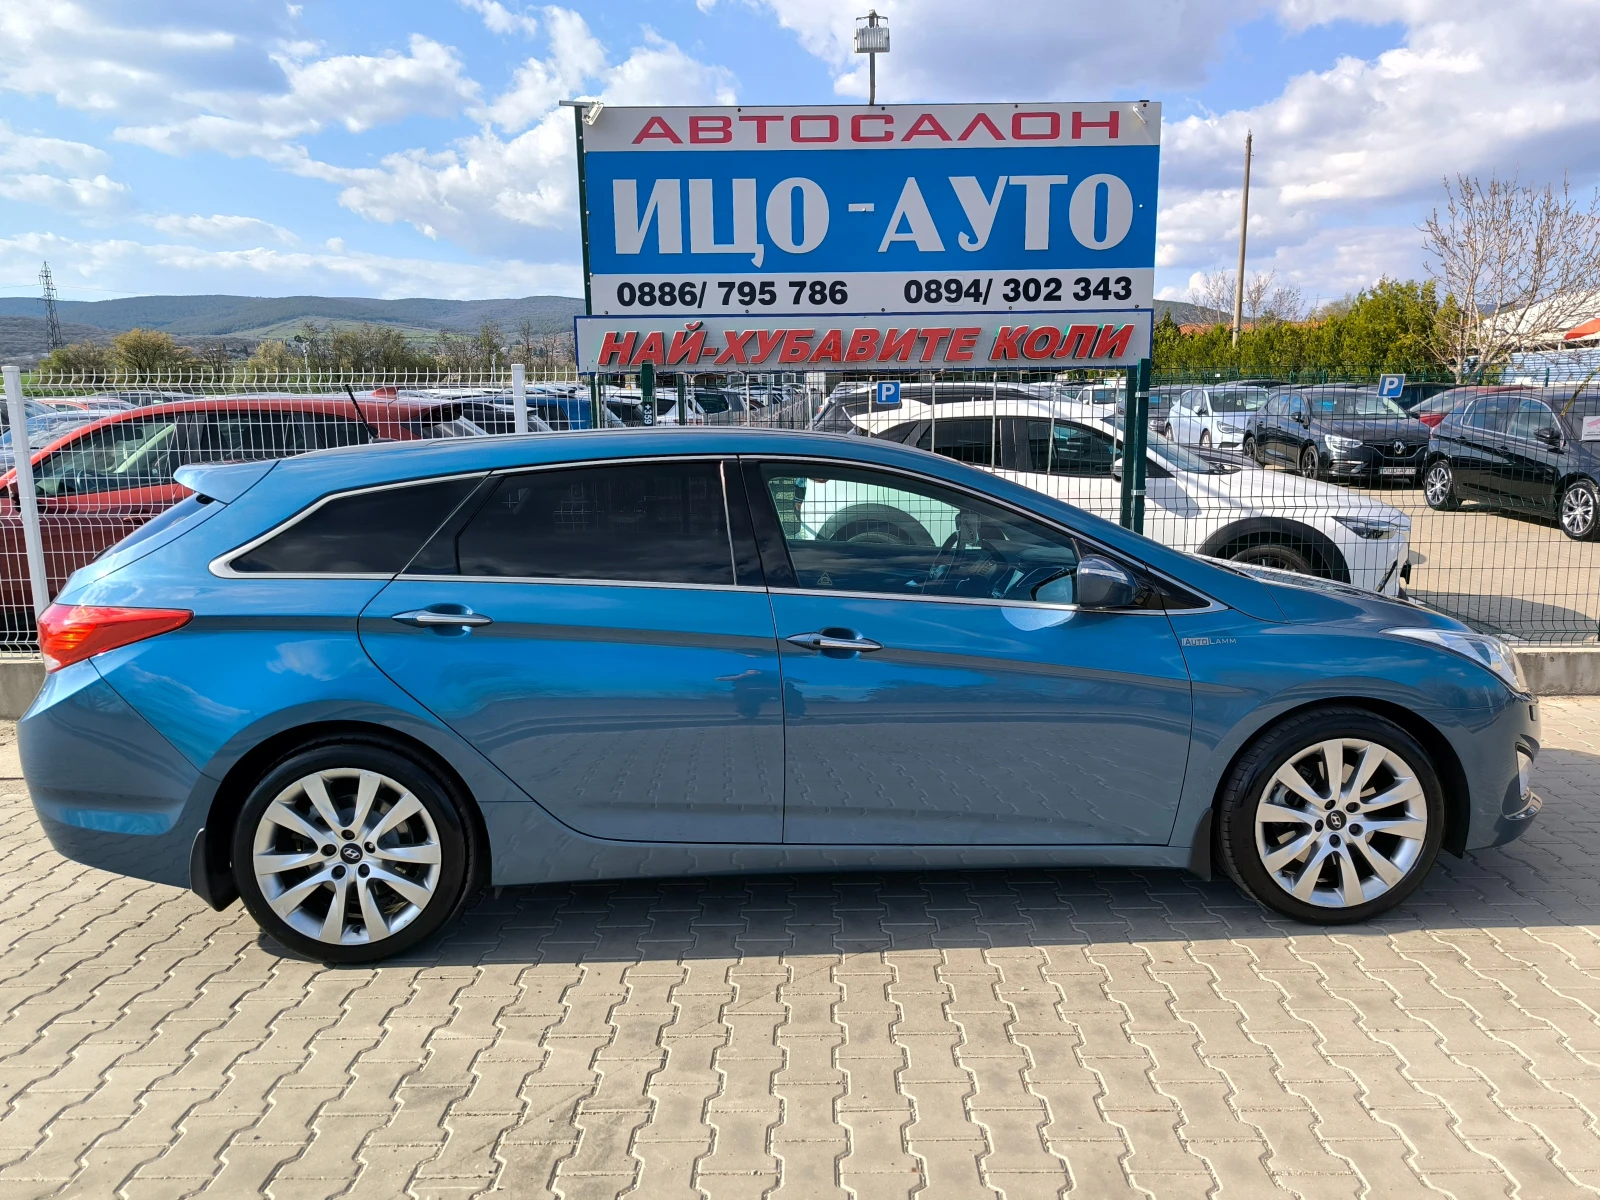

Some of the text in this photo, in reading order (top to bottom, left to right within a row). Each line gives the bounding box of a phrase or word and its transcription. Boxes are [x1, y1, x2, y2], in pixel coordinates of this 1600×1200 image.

[632, 110, 1120, 145] АВТОСАЛОН
[616, 277, 1133, 309] 0886/ 795 786 0894/ 302 343
[597, 321, 1135, 366] НАЙ-ХУБАВИТЕ КОЛИ
[882, 383, 895, 401] P
[1383, 377, 1398, 394] P
